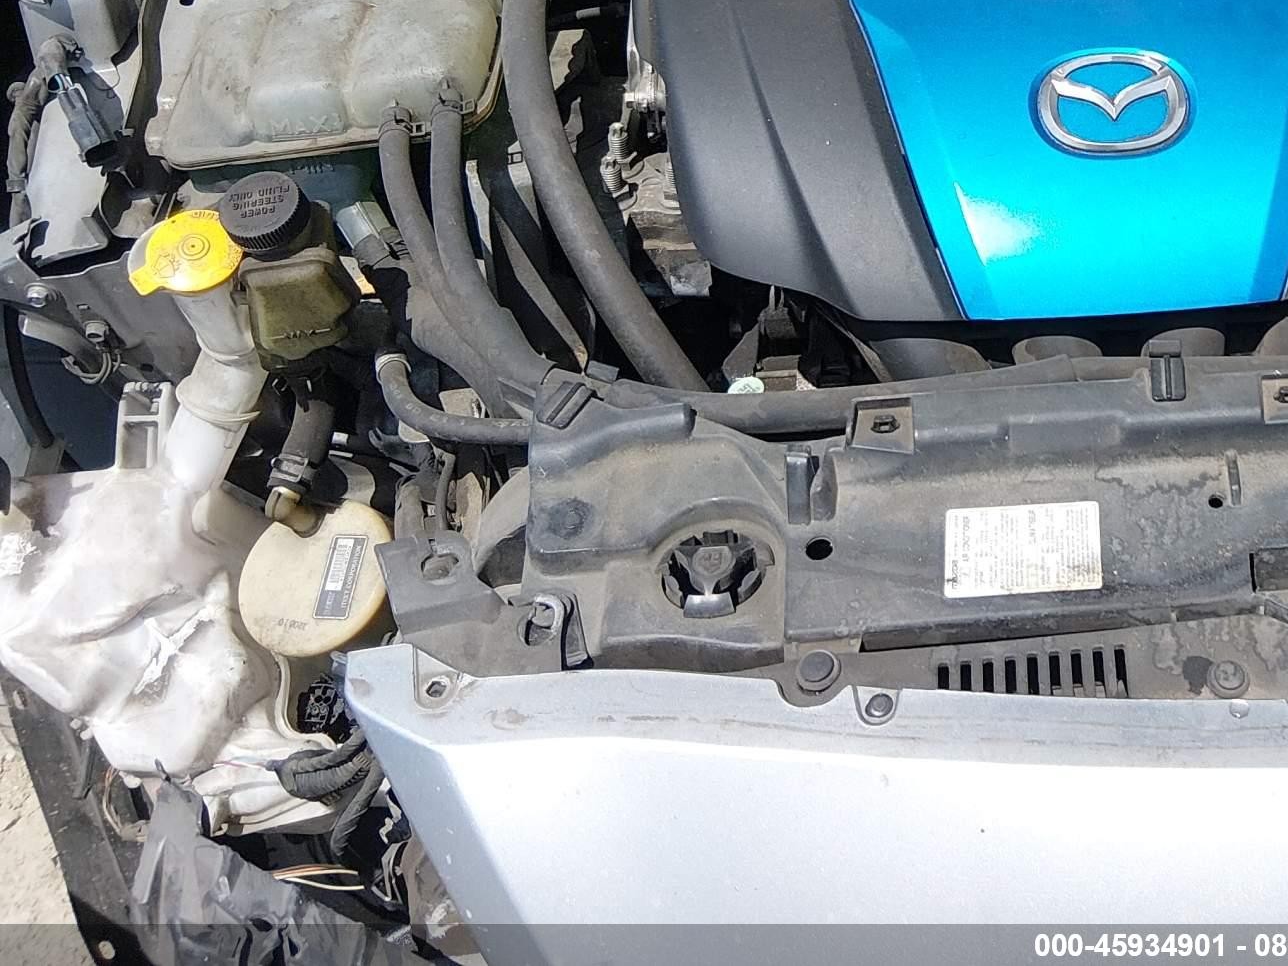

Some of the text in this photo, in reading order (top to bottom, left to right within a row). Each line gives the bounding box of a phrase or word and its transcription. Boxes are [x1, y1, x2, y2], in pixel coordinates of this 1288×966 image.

[229, 185, 290, 203] FLUID ONLY
[233, 194, 284, 210] STEERING
[240, 206, 275, 218] POWER
